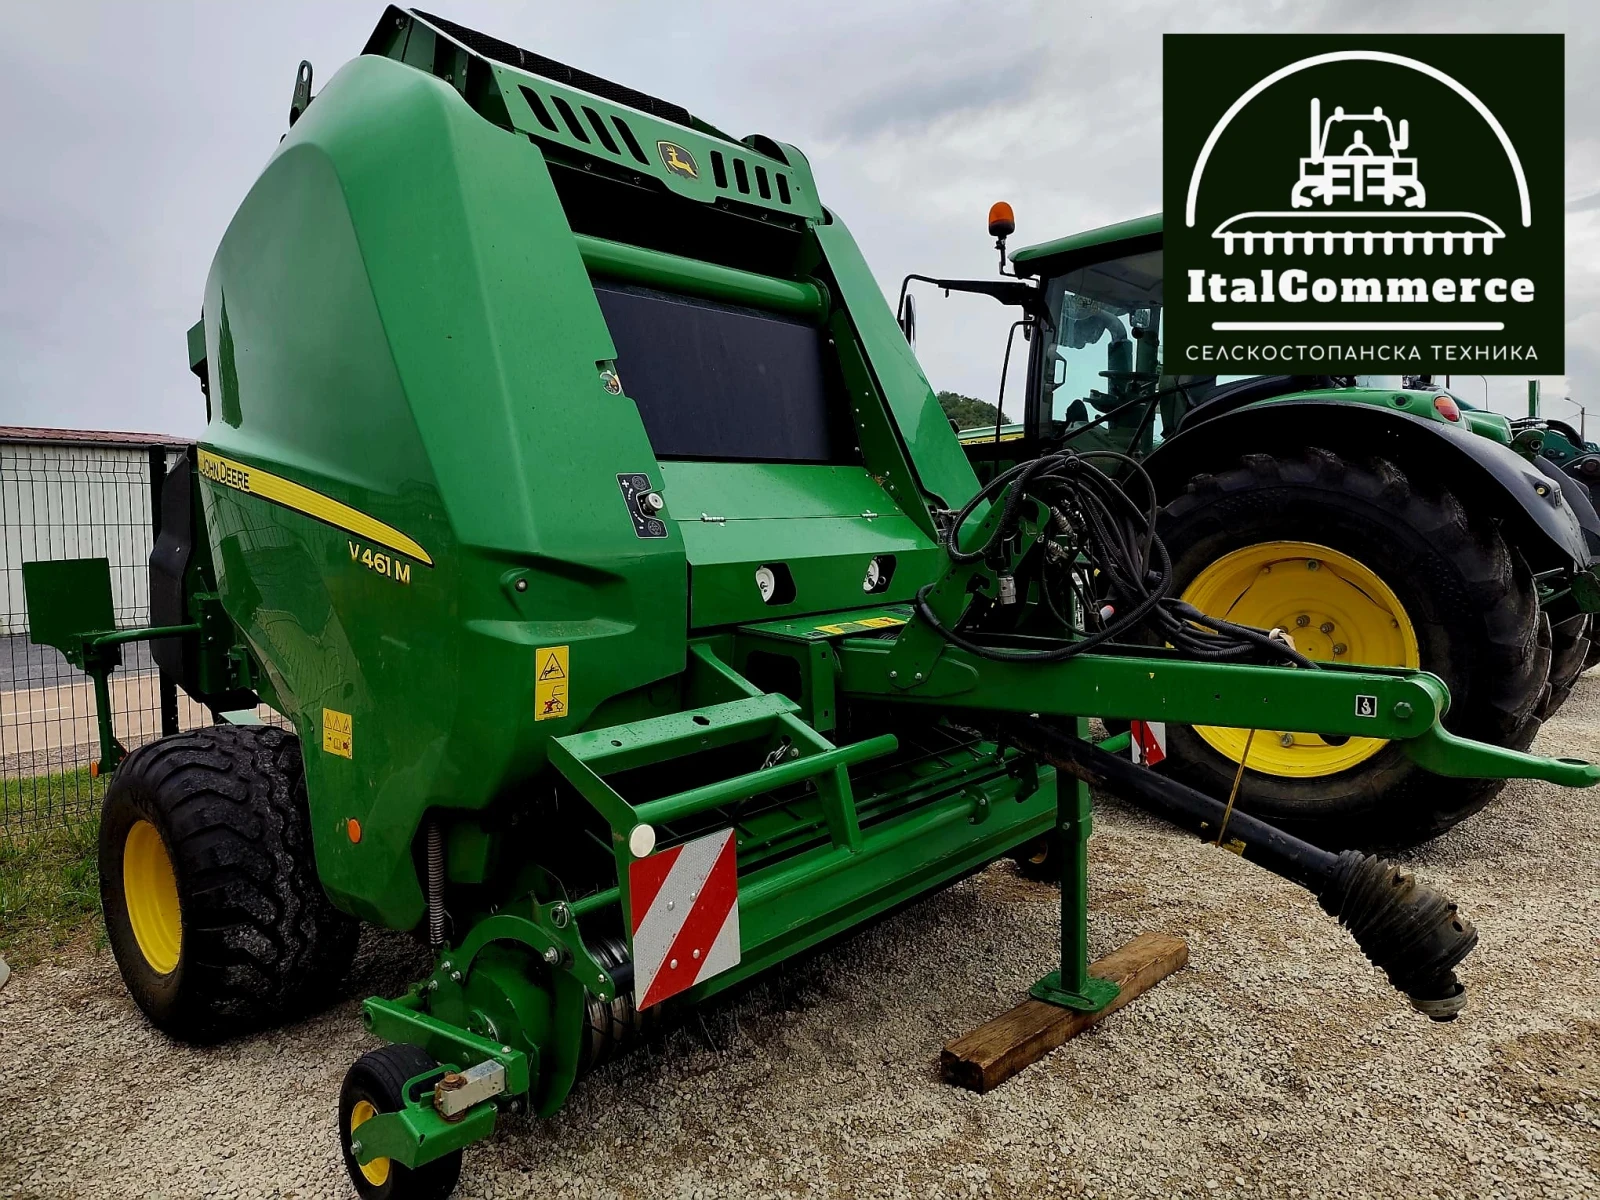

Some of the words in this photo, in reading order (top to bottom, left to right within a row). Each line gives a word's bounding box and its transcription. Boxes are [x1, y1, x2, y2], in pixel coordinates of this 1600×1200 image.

[202, 456, 220, 481] JOHN
[220, 461, 250, 490] DEERE
[348, 540, 360, 561] V
[362, 548, 391, 577] 461
[395, 560, 410, 584] M
